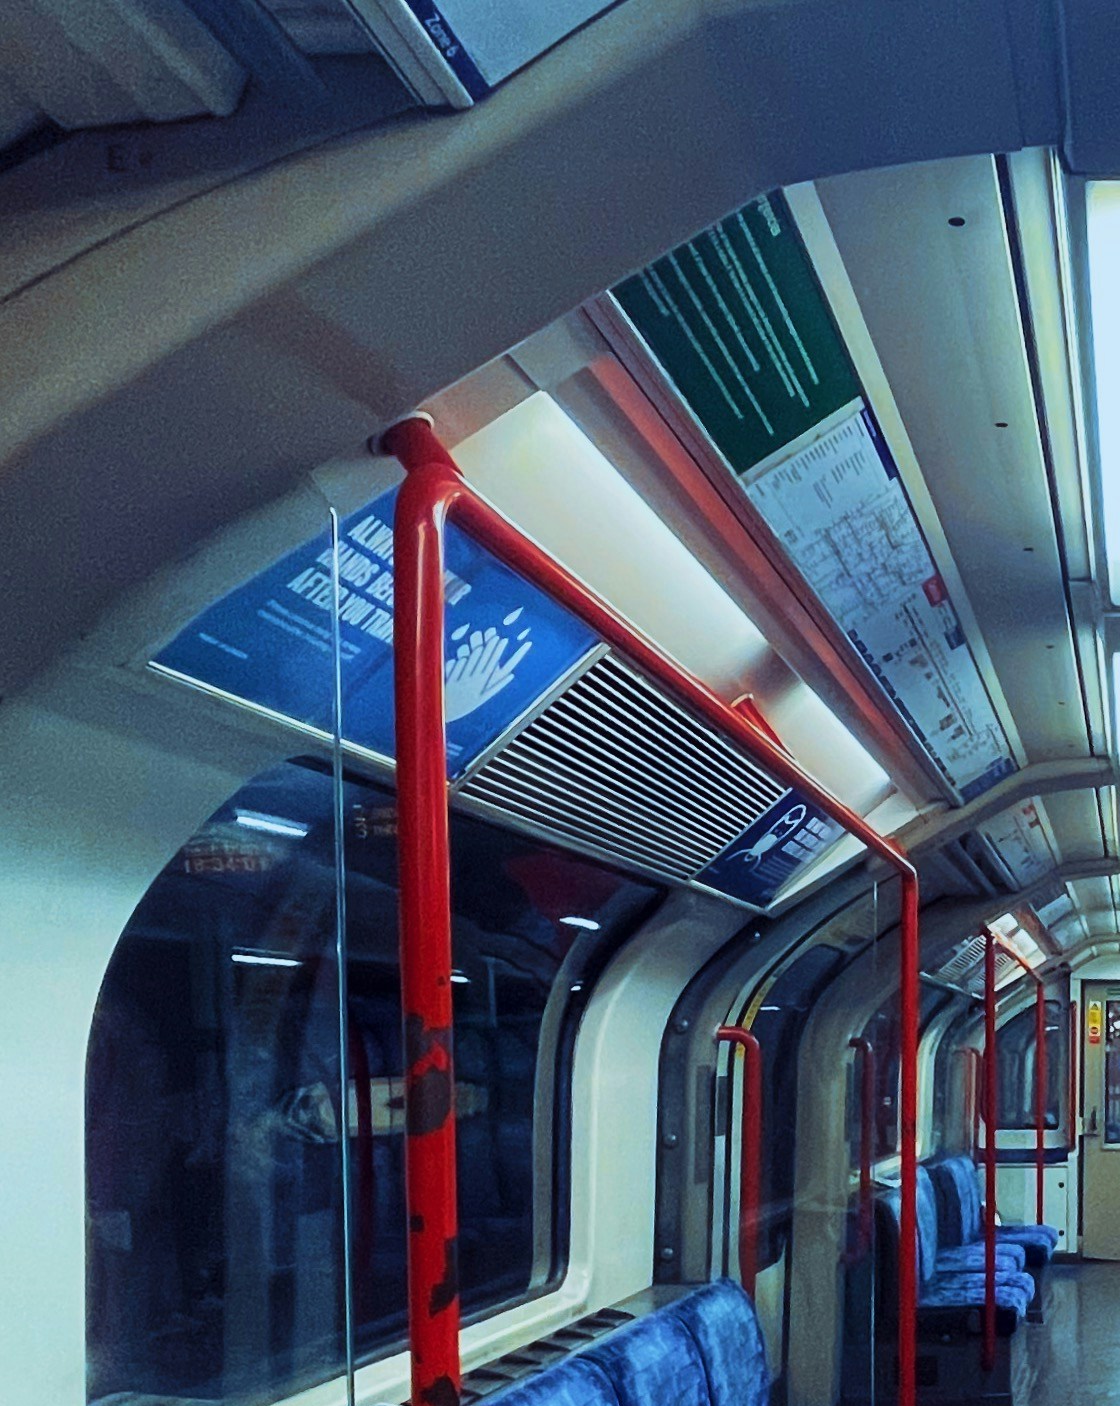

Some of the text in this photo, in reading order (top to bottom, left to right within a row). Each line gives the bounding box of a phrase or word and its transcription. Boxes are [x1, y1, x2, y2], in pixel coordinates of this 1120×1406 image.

[424, 12, 459, 57] Zone 6
[347, 515, 394, 566] ALWA
[286, 567, 350, 612] AFTER
[339, 593, 376, 626] YOU
